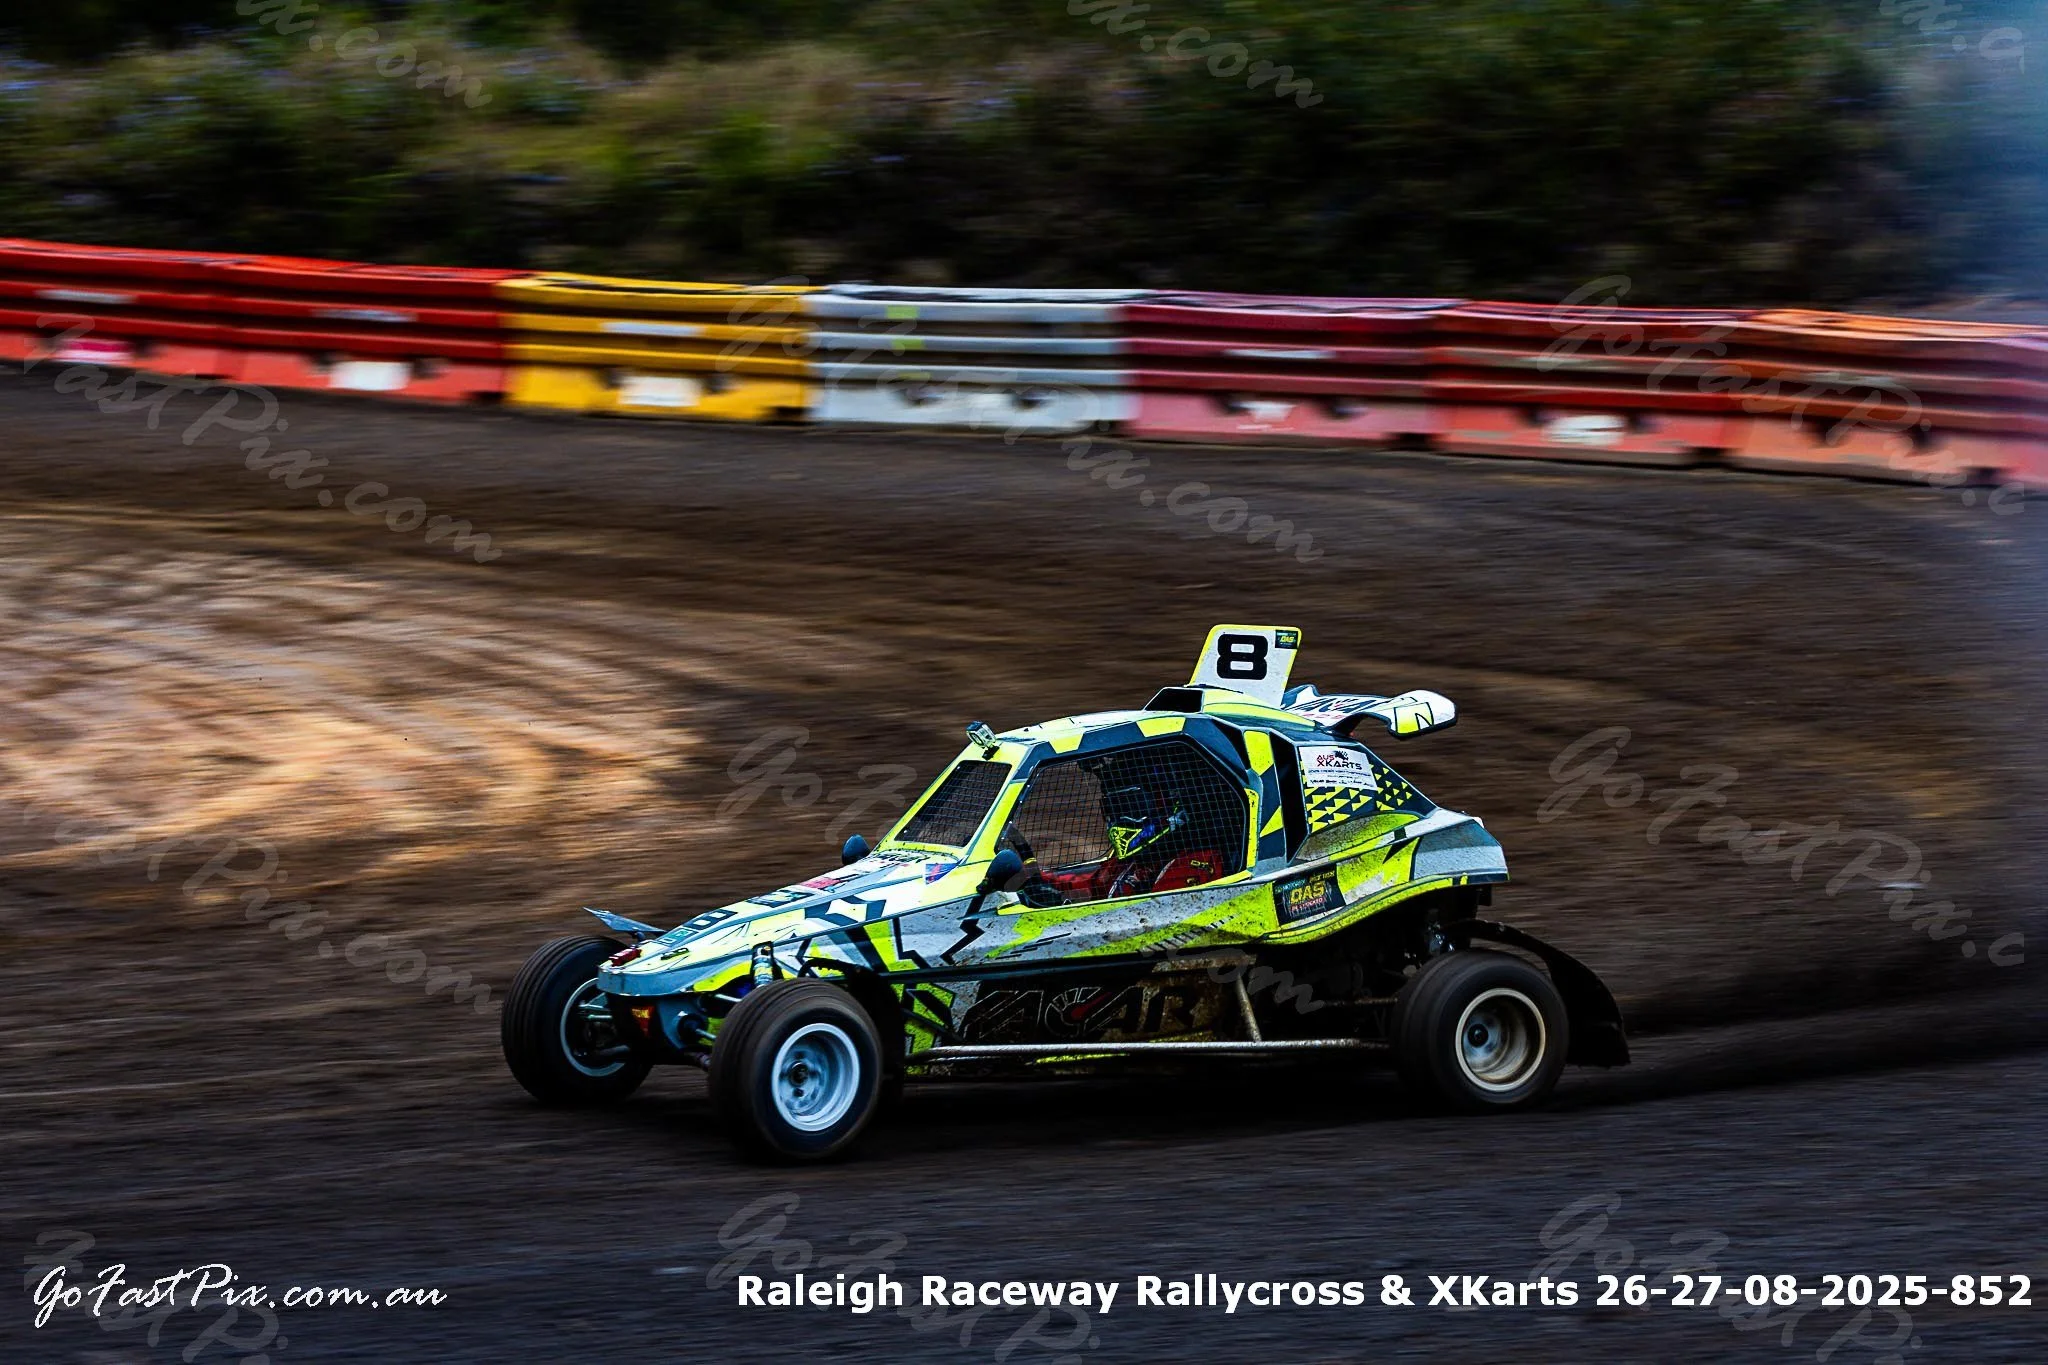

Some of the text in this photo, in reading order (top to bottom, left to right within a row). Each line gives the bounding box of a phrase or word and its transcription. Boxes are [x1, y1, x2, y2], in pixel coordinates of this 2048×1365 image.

[1217, 634, 1268, 680] 8
[1317, 760, 1363, 770] XKARTS
[1290, 880, 1326, 904] DAS
